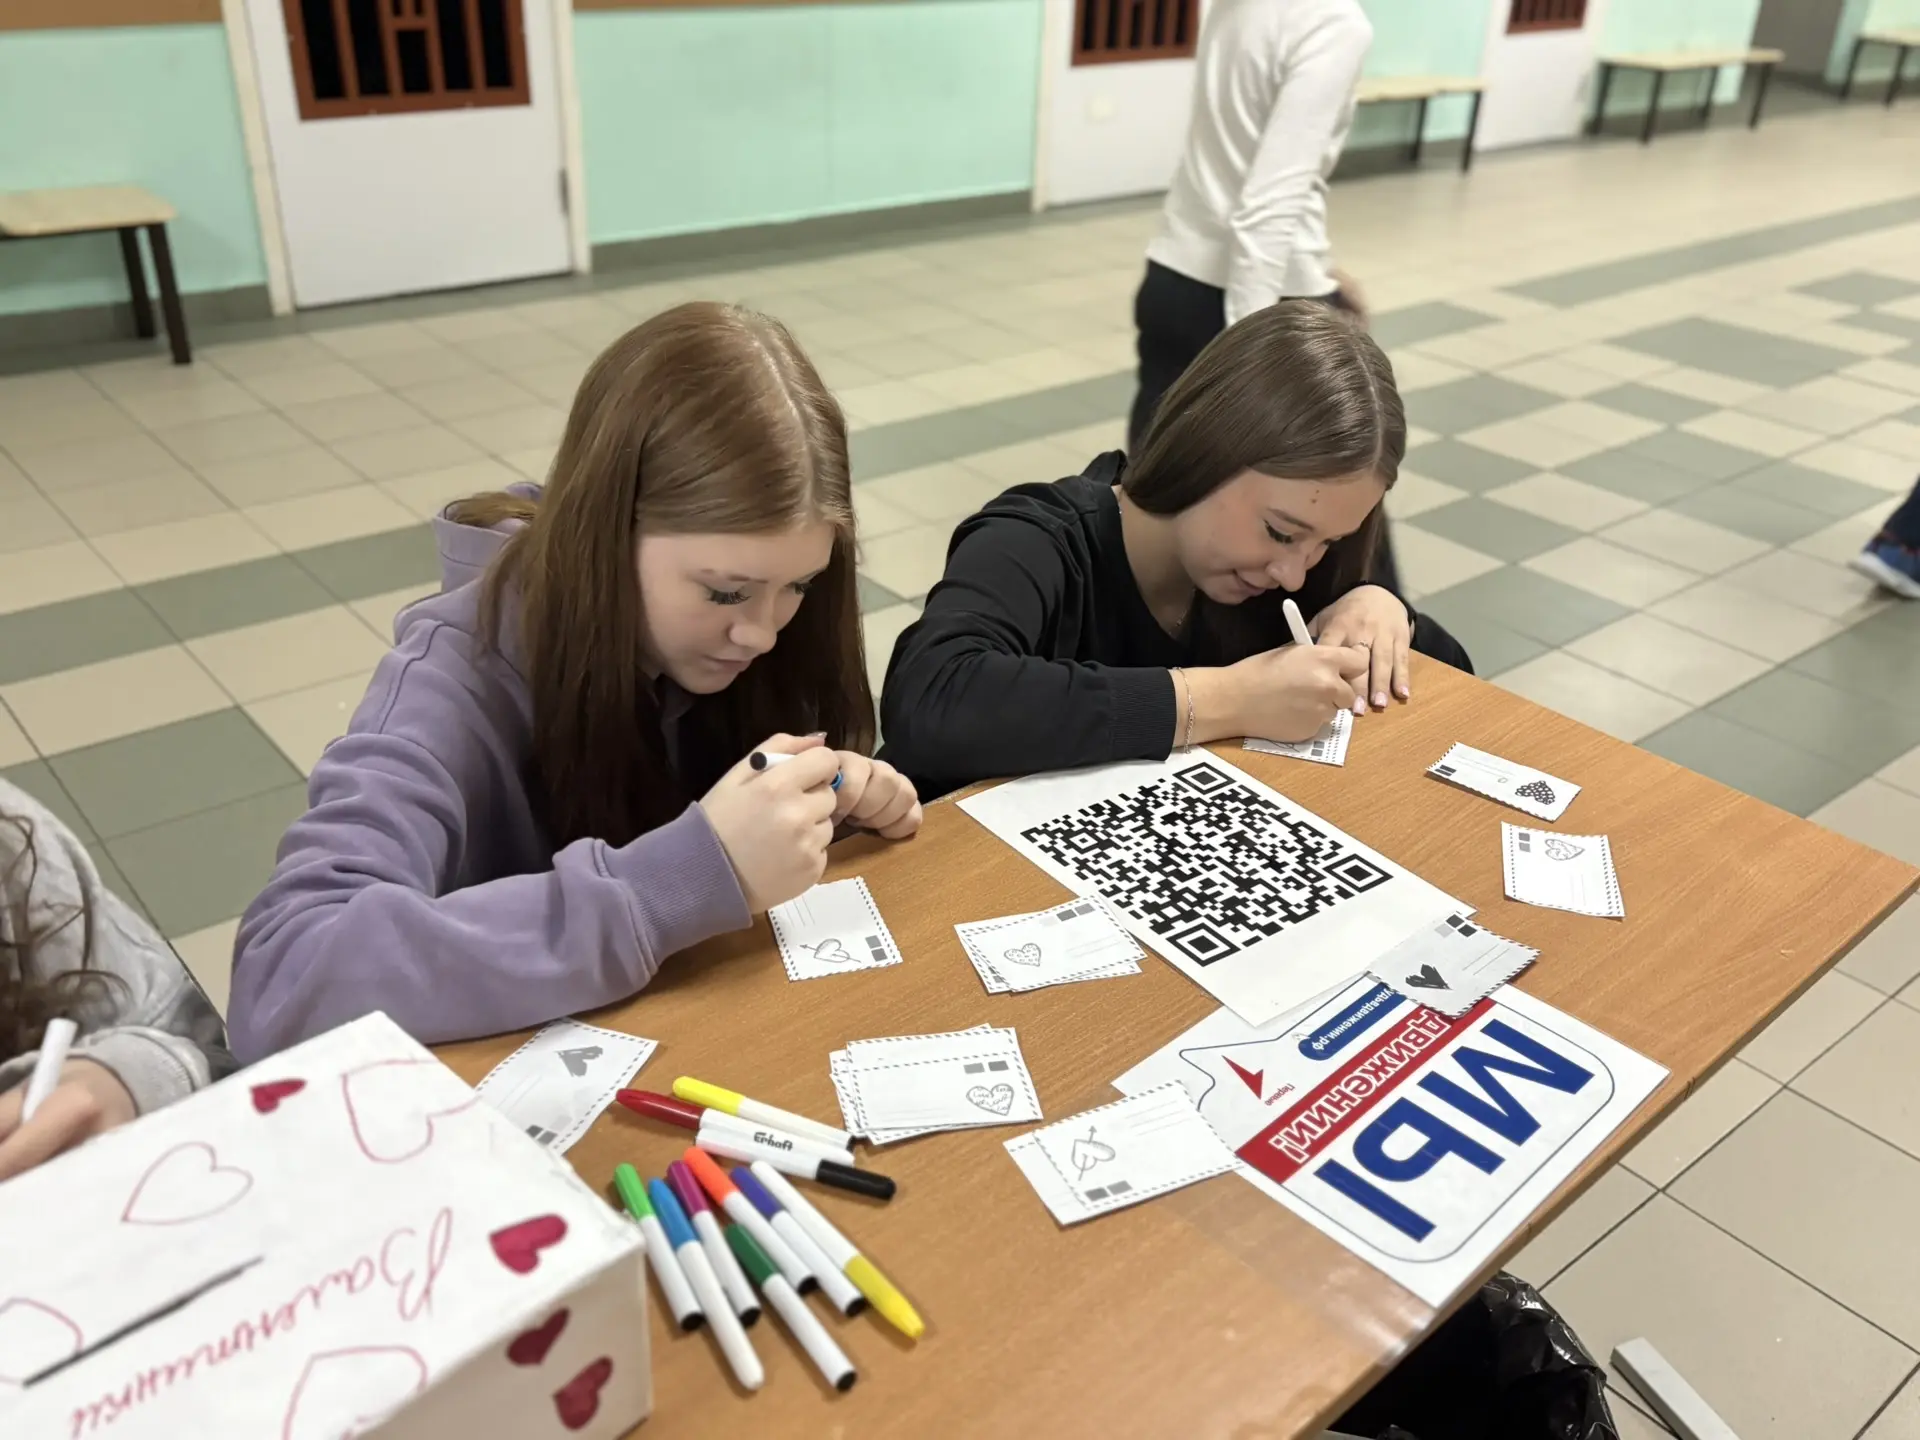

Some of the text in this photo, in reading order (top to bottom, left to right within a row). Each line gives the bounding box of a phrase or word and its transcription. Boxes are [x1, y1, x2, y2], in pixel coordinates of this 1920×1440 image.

[1311, 984, 1397, 1052] удьвдвижении.рф
[1264, 1083, 1296, 1107] Первые
[1313, 1018, 1596, 1243] МЫ
[70, 1206, 453, 1439] Валентинки
